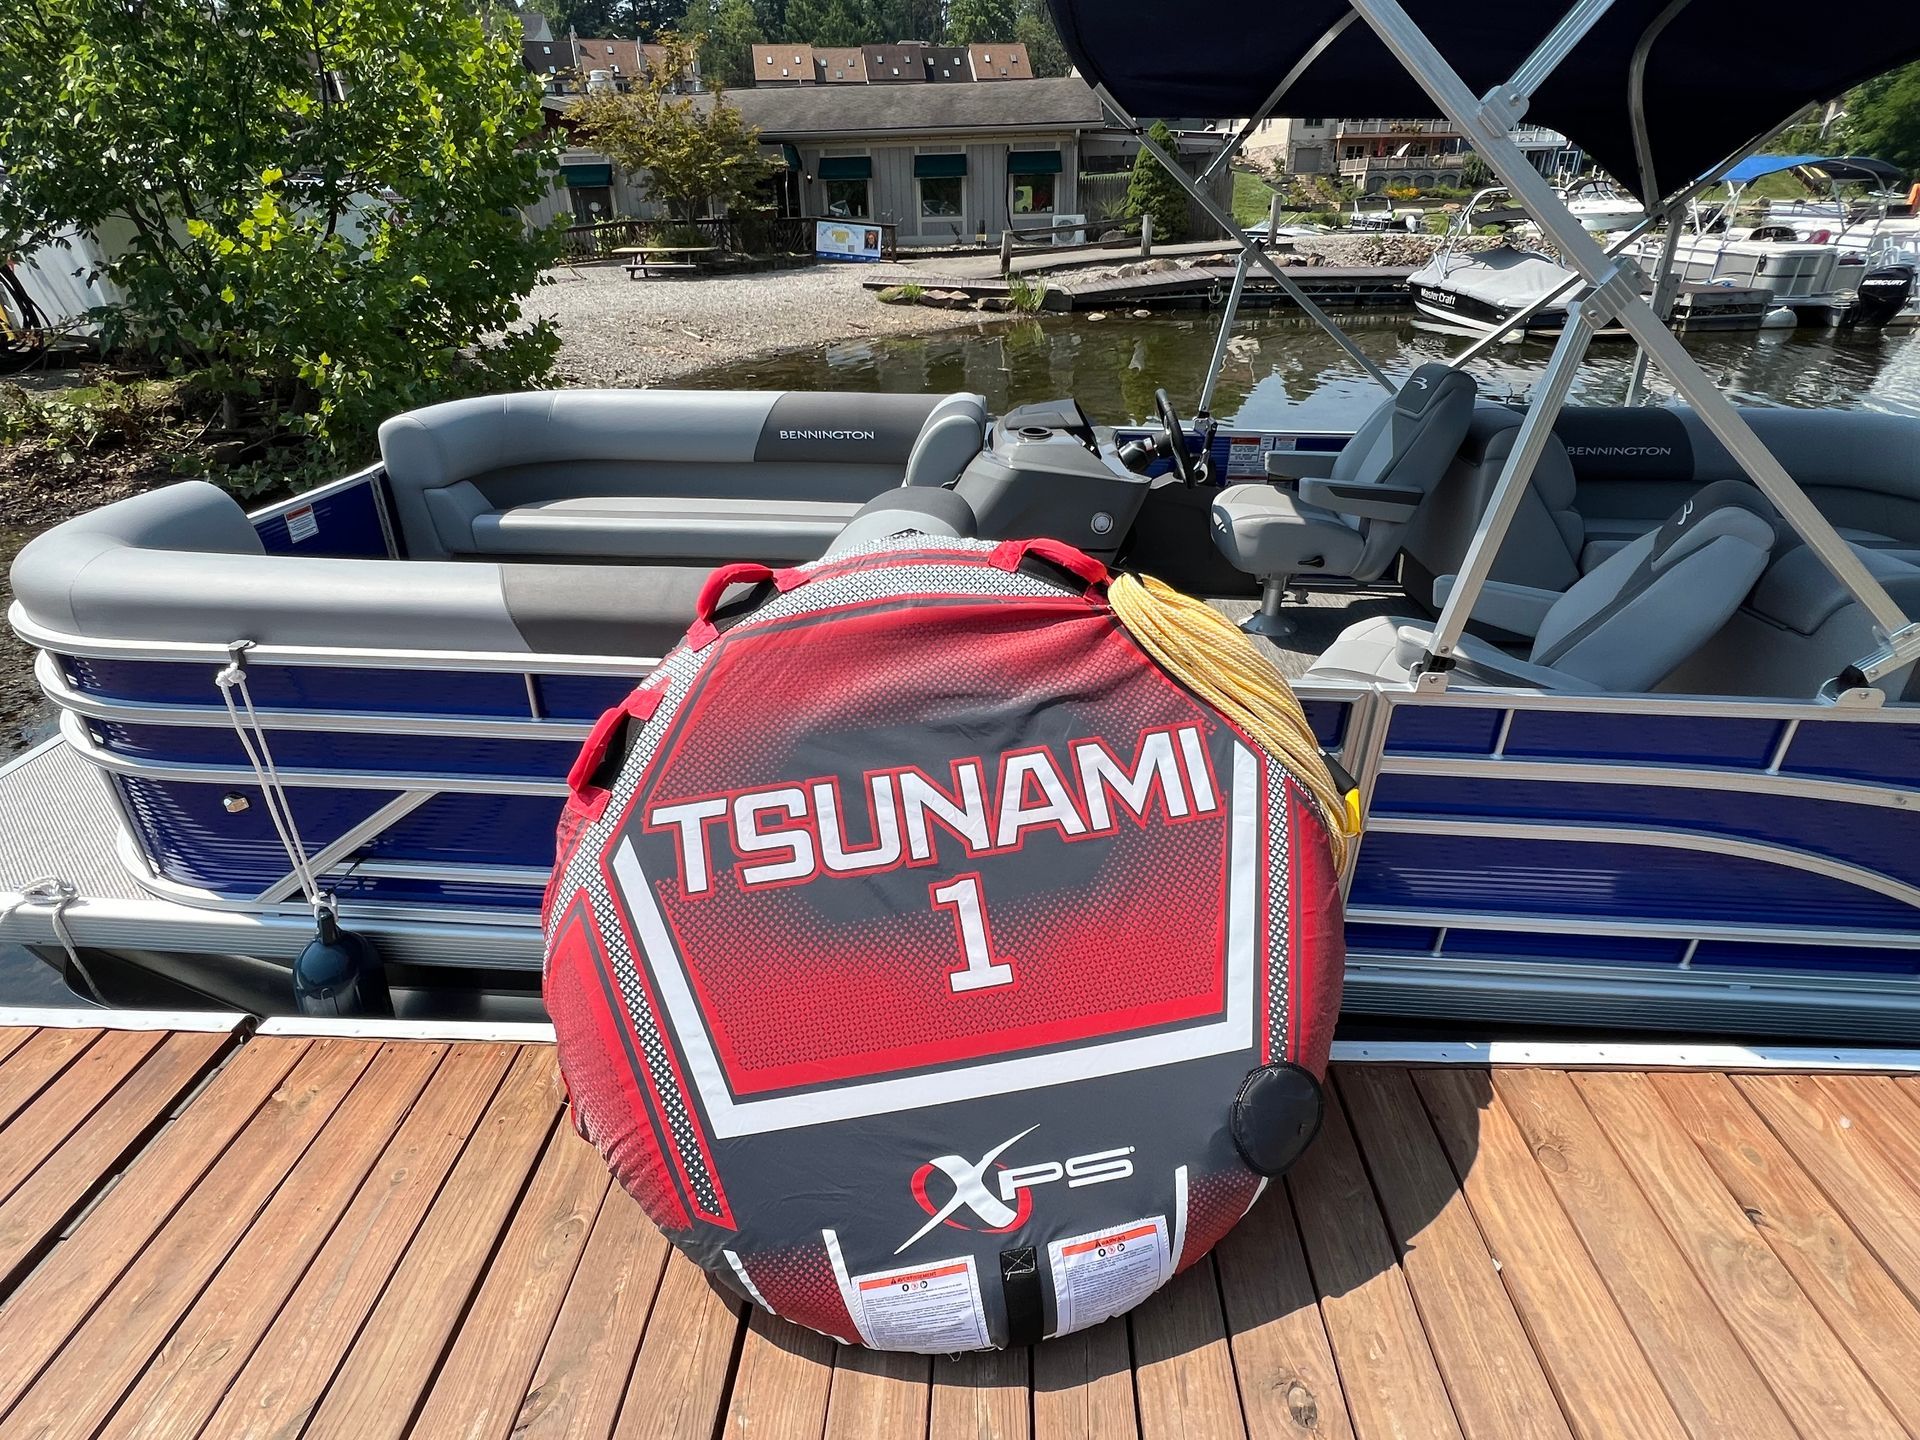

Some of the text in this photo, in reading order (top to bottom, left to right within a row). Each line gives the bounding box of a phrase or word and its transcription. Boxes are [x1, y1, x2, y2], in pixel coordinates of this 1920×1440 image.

[779, 430, 875, 440] BENNINGTON
[1567, 446, 1672, 456] BENNINGTON
[647, 724, 1221, 896] TSUNAMI
[933, 874, 1018, 996] 1
[893, 1123, 1134, 1255] XPS
